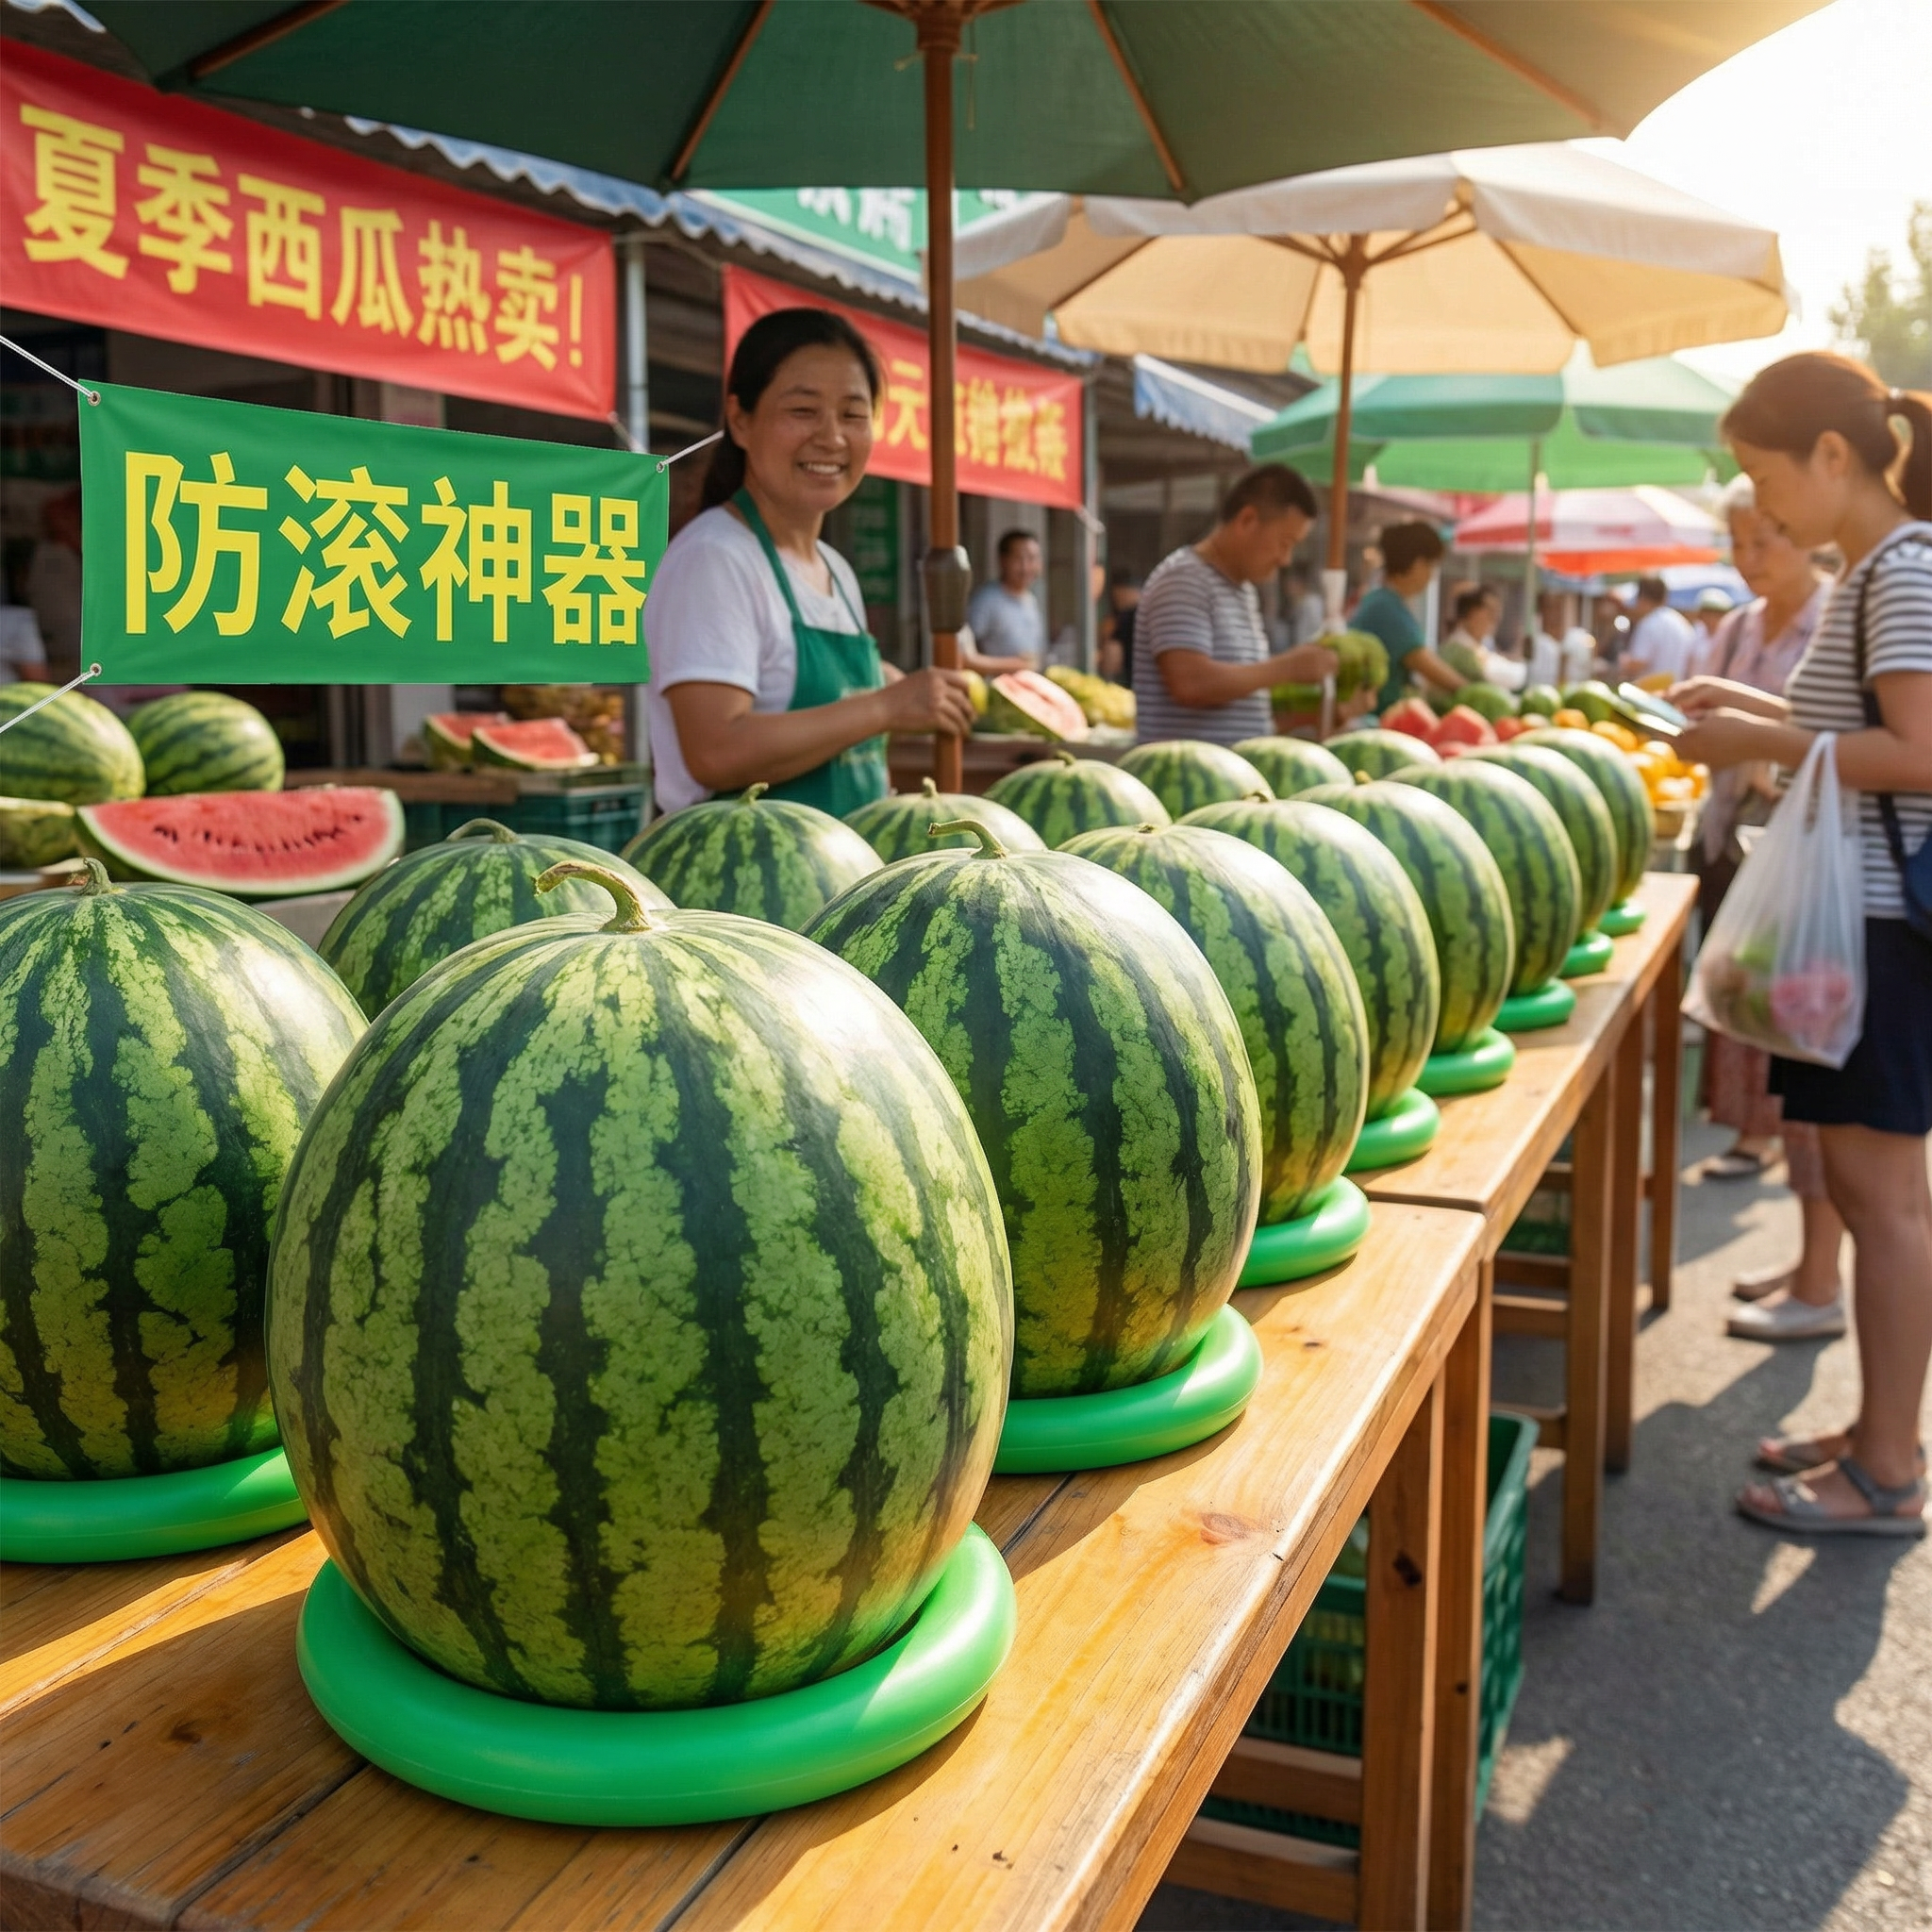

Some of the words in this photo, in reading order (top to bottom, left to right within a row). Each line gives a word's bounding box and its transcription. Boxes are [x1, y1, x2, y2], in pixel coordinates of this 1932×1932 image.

[19, 103, 583, 372] 夏季西瓜热卖!
[125, 450, 646, 645] 防滚神器
